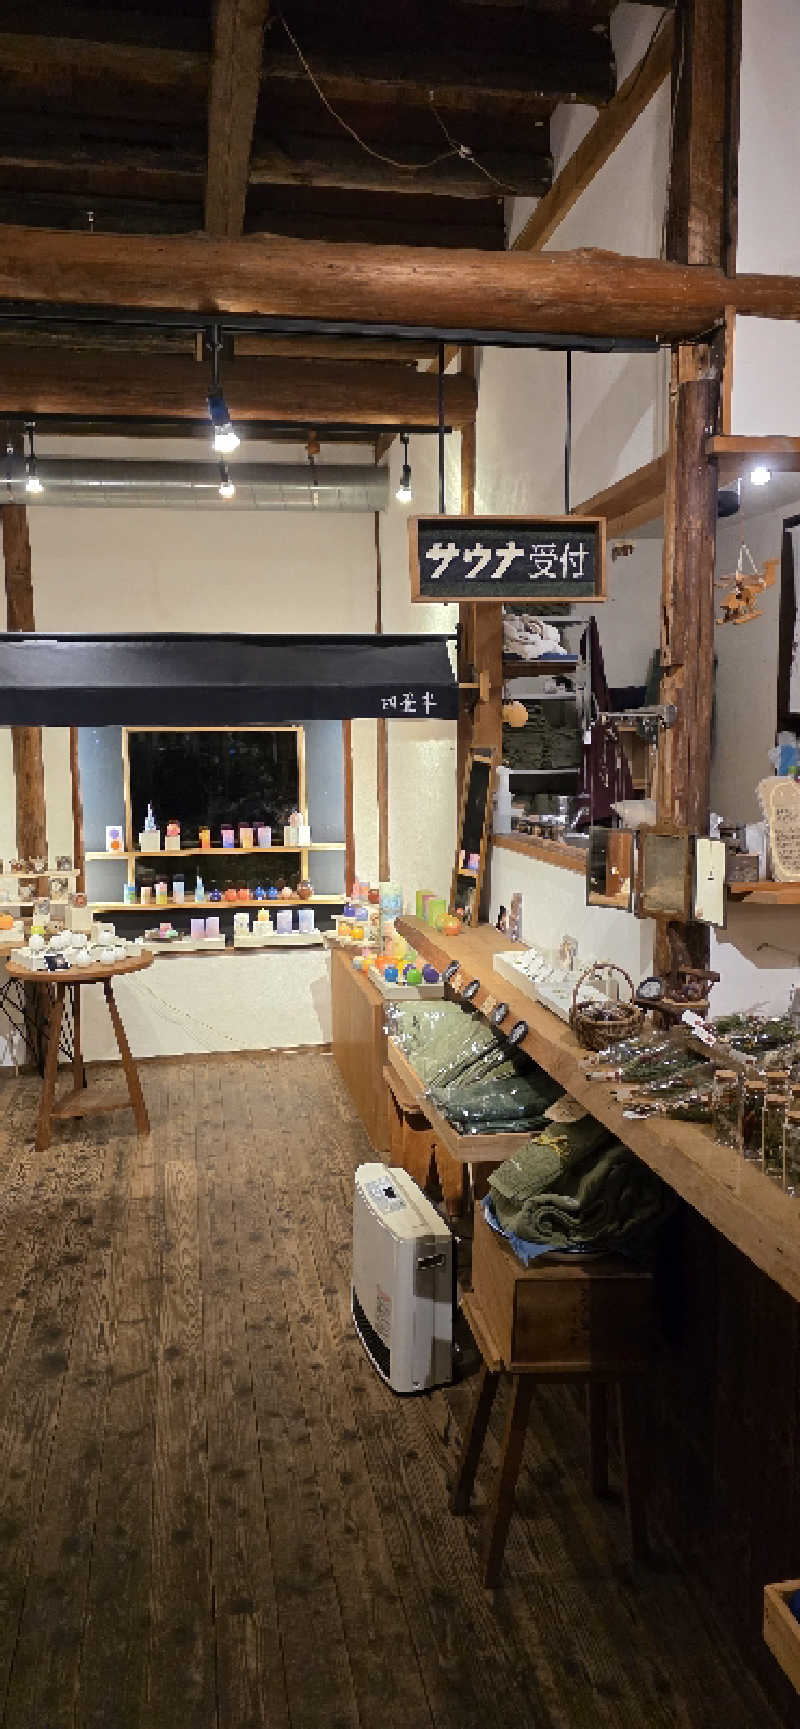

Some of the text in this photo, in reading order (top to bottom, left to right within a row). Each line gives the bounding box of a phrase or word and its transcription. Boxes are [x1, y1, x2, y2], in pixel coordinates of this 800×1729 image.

[425, 541, 590, 579] サウナ受付
